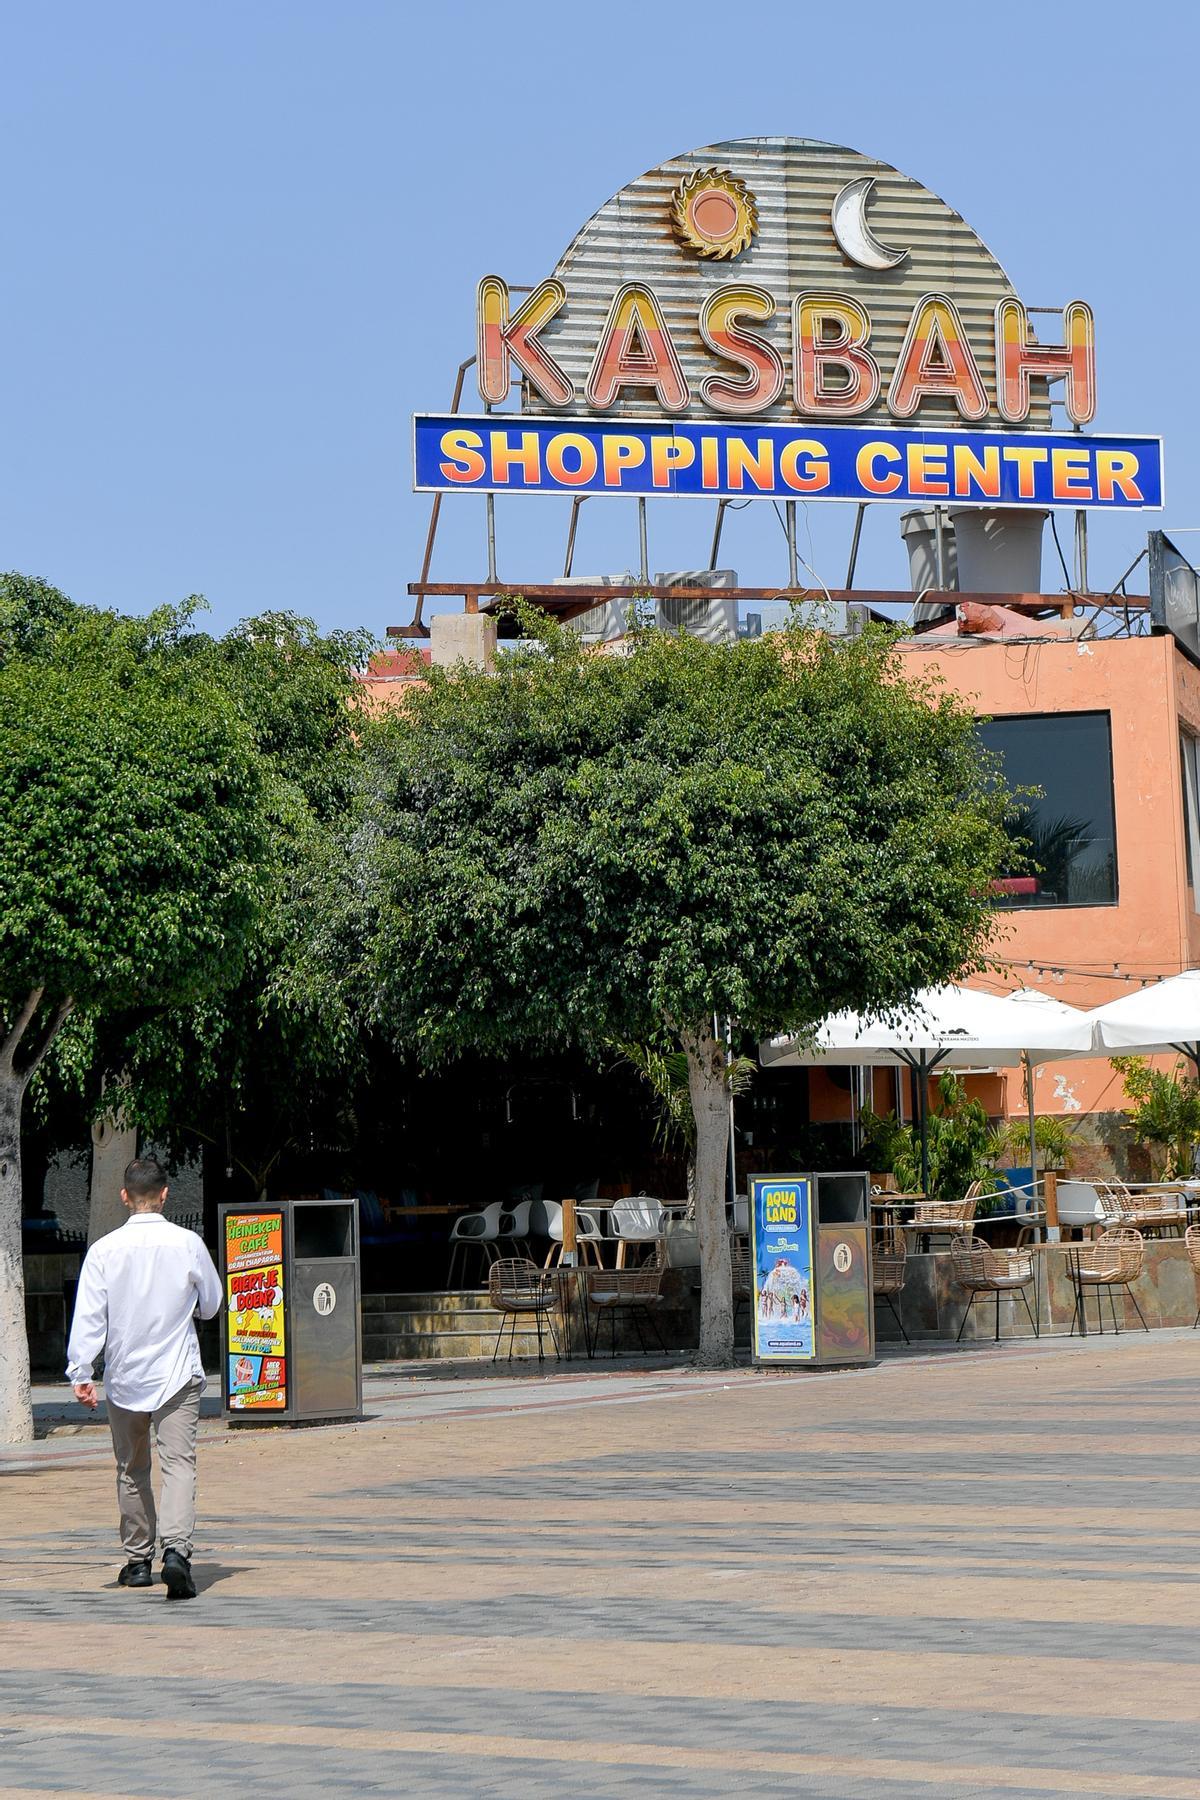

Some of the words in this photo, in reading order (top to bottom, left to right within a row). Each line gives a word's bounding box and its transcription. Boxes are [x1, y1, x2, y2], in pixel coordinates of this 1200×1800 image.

[476, 273, 1097, 426] KASBAH
[439, 428, 831, 494] SHOPPING
[855, 440, 1146, 503] CENTER
[766, 1191, 796, 1207] AQUA
[766, 1206, 797, 1222] LAND
[228, 1219, 280, 1240] HEINEKEN
[240, 1234, 268, 1253] CAFÉ
[237, 1289, 275, 1311] DOEN?
